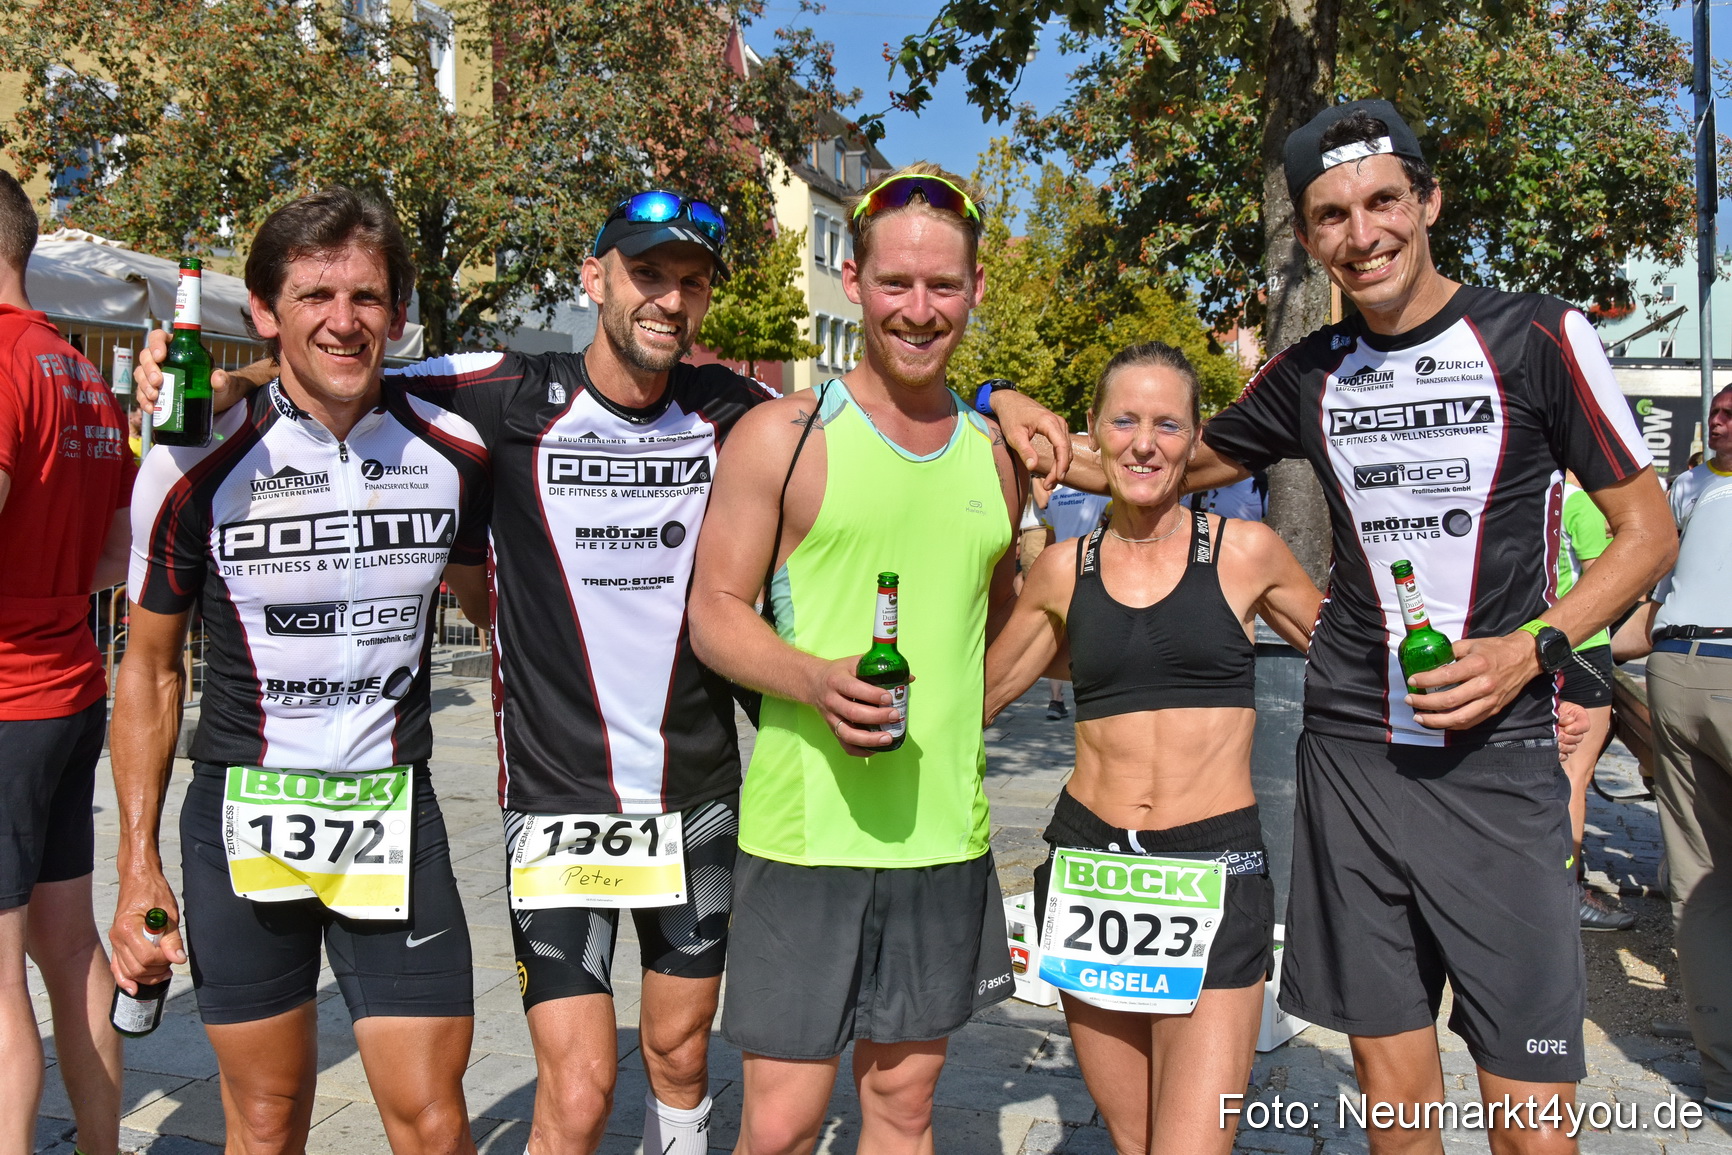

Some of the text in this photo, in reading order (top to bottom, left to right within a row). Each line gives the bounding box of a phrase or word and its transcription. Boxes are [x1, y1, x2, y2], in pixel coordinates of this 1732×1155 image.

[1437, 360, 1484, 370] ZURICH
[1338, 372, 1395, 386] WOLFRUM
[558, 435, 627, 445] BAUUNTERNEHMEN
[1331, 425, 1489, 447] DIE FITNESS & WELLNESSGRUPPE
[385, 465, 429, 475] ZURICH
[552, 457, 704, 484] POSITIV
[1358, 465, 1464, 484] varidee
[251, 473, 330, 493] WOLFRUM
[1411, 485, 1472, 495] Profiltechnik GmbH
[251, 486, 331, 502] BAUUNTERNEHMEN
[549, 485, 706, 499] DIE FITNESS & WELLNESSGRUPPE
[575, 525, 658, 539] BRÖTJE
[1361, 516, 1440, 533] BRÖTJE
[575, 541, 658, 550] HEIZUNG
[1362, 530, 1441, 544] HEIZUNG
[1197, 545, 1210, 563] PUSH
[223, 552, 449, 576] DIE FITNESS & WELLNESSGRUPPE
[272, 603, 417, 630] varidee
[357, 635, 402, 647] Profiltechnik
[266, 676, 382, 695] BRÖTJE
[266, 694, 378, 706] HEIZUNG
[245, 768, 395, 805] BOCK
[248, 814, 385, 865] 1372
[543, 818, 660, 857] 1361
[559, 866, 624, 887] Peter
[1066, 859, 1205, 901] BOCK
[1063, 905, 1199, 958] 2023
[987, 972, 1011, 989] asics
[1079, 968, 1170, 994] GISELA
[1526, 1038, 1568, 1055] GORE
